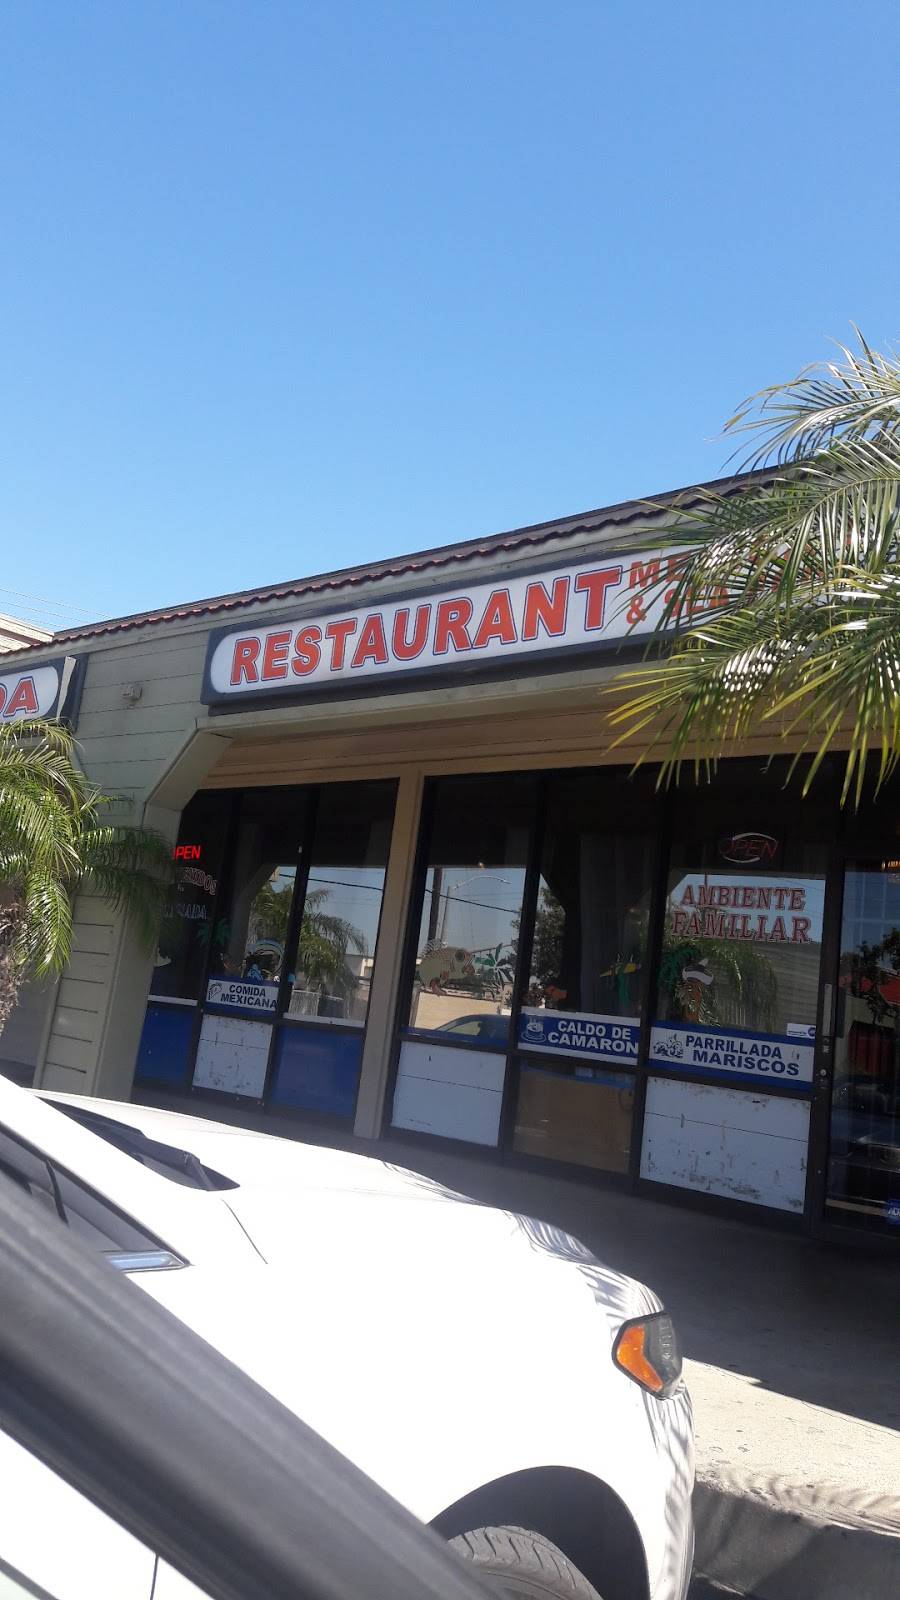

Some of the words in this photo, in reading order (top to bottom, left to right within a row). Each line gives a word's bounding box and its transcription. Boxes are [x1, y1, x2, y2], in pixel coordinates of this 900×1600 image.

[230, 567, 622, 685] RESTAURANT
[172, 845, 201, 860] PEN
[681, 886, 805, 911] AMBIENTE
[671, 910, 813, 944] FAMILIAR
[220, 993, 278, 1009] MEXICANA
[229, 984, 266, 997] COMIDA
[557, 1019, 606, 1037] CALDO
[611, 1026, 632, 1041] DE
[547, 1031, 639, 1055] CAMARON
[685, 1033, 782, 1059] PARRILLADA
[692, 1048, 800, 1077] MARISCOS
